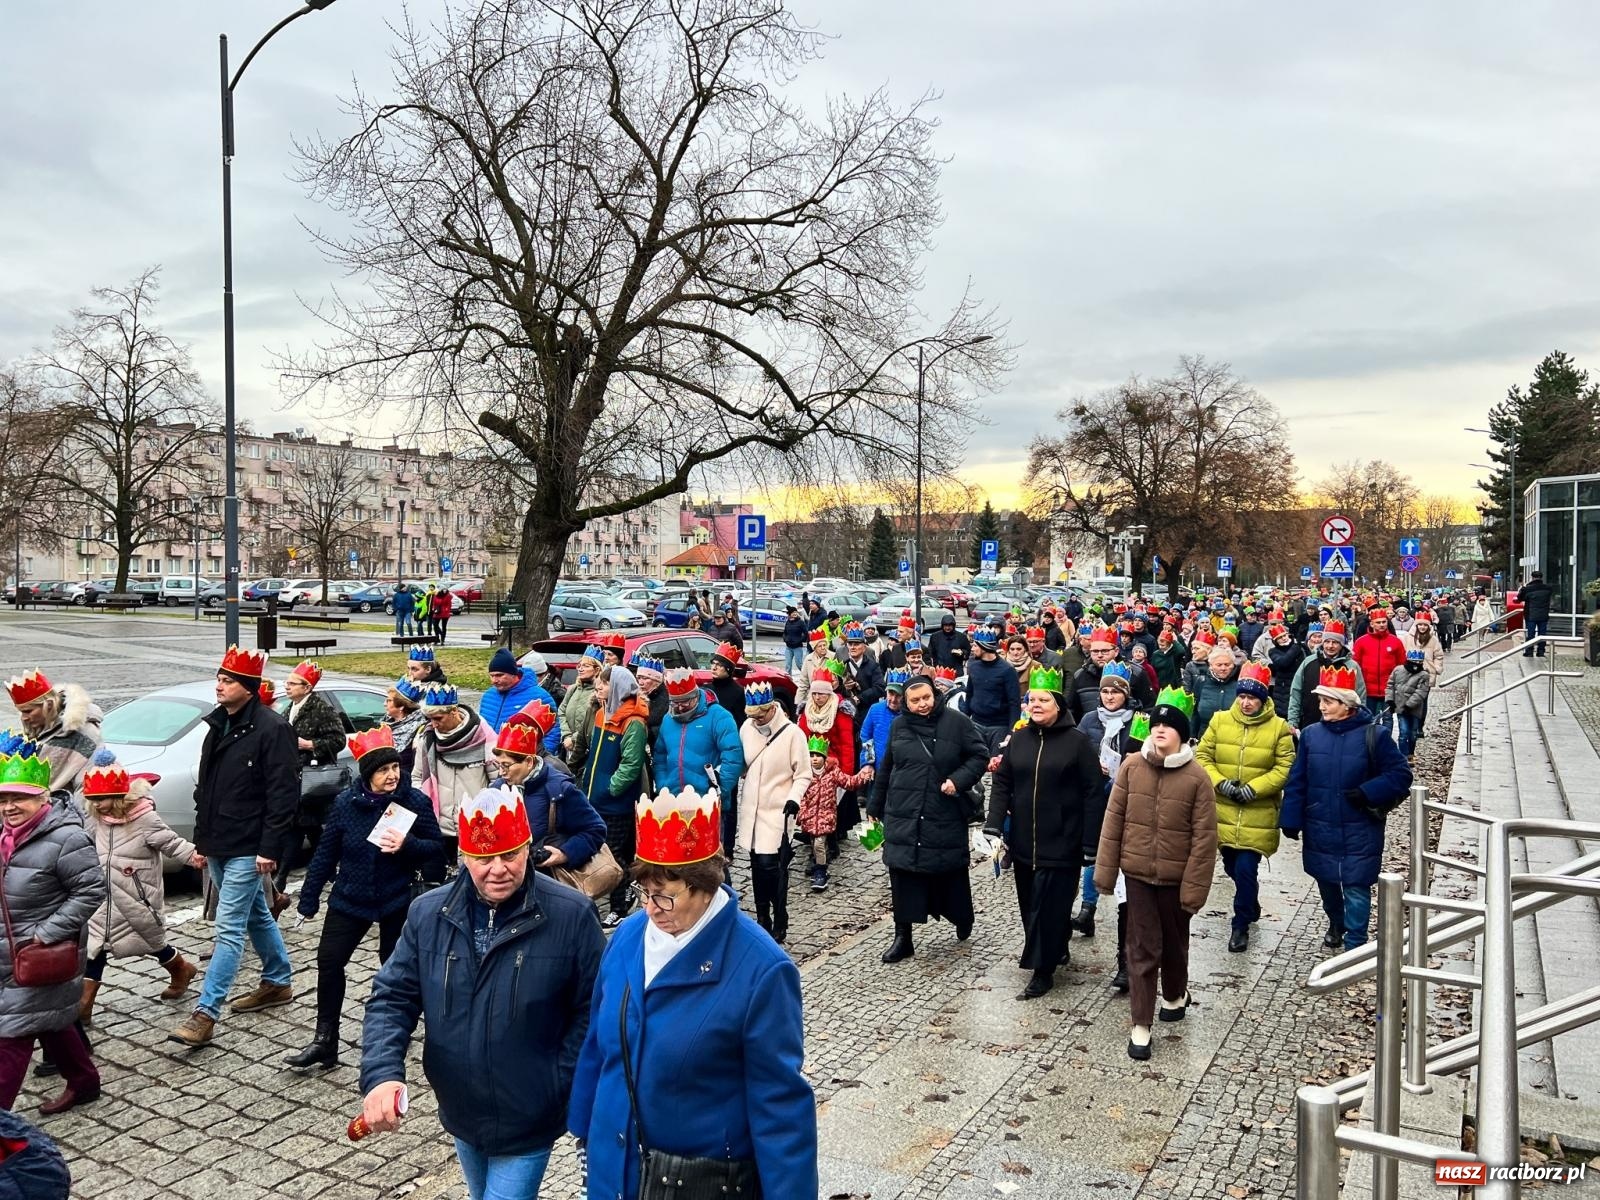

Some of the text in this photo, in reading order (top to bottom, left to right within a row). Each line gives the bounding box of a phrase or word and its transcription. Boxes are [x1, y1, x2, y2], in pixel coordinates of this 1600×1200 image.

[744, 518, 760, 546] P
[985, 542, 995, 555] P
[901, 561, 907, 571] P
[1220, 558, 1230, 569] P
[1303, 567, 1310, 575] P
